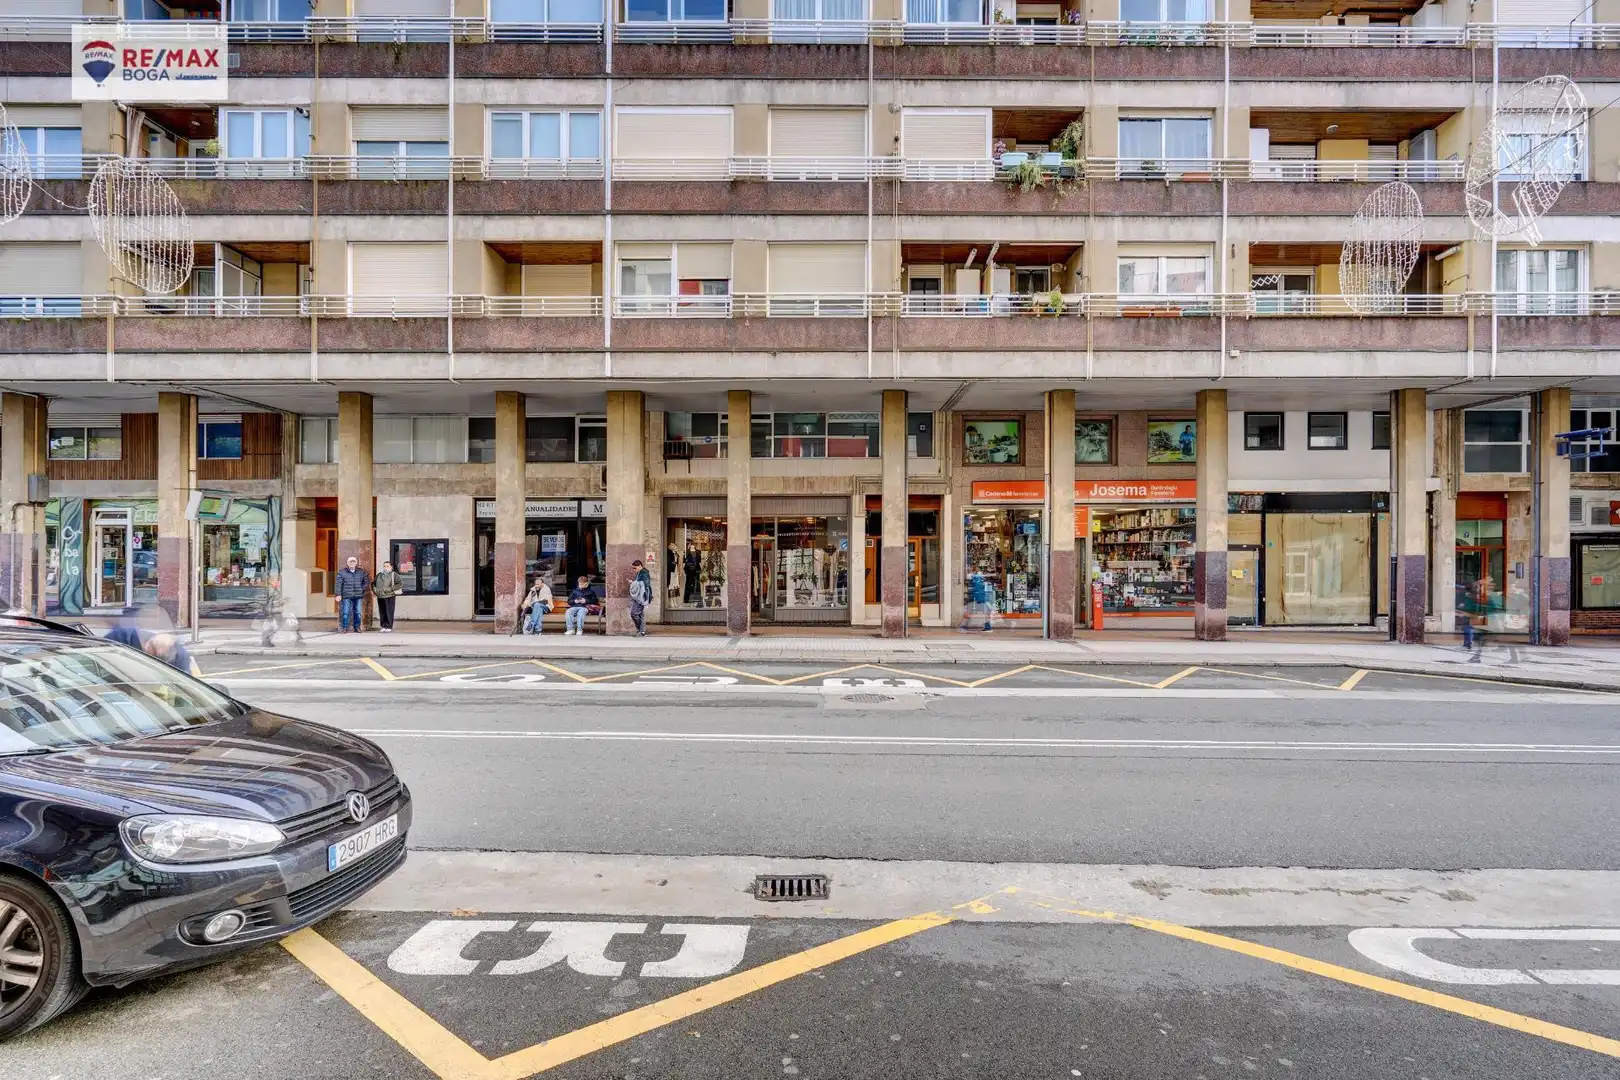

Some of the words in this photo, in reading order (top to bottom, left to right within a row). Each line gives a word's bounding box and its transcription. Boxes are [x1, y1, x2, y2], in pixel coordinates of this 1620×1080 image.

[1090, 483, 1147, 497] Josema
[339, 832, 371, 862] 2907
[374, 819, 395, 844] HRG
